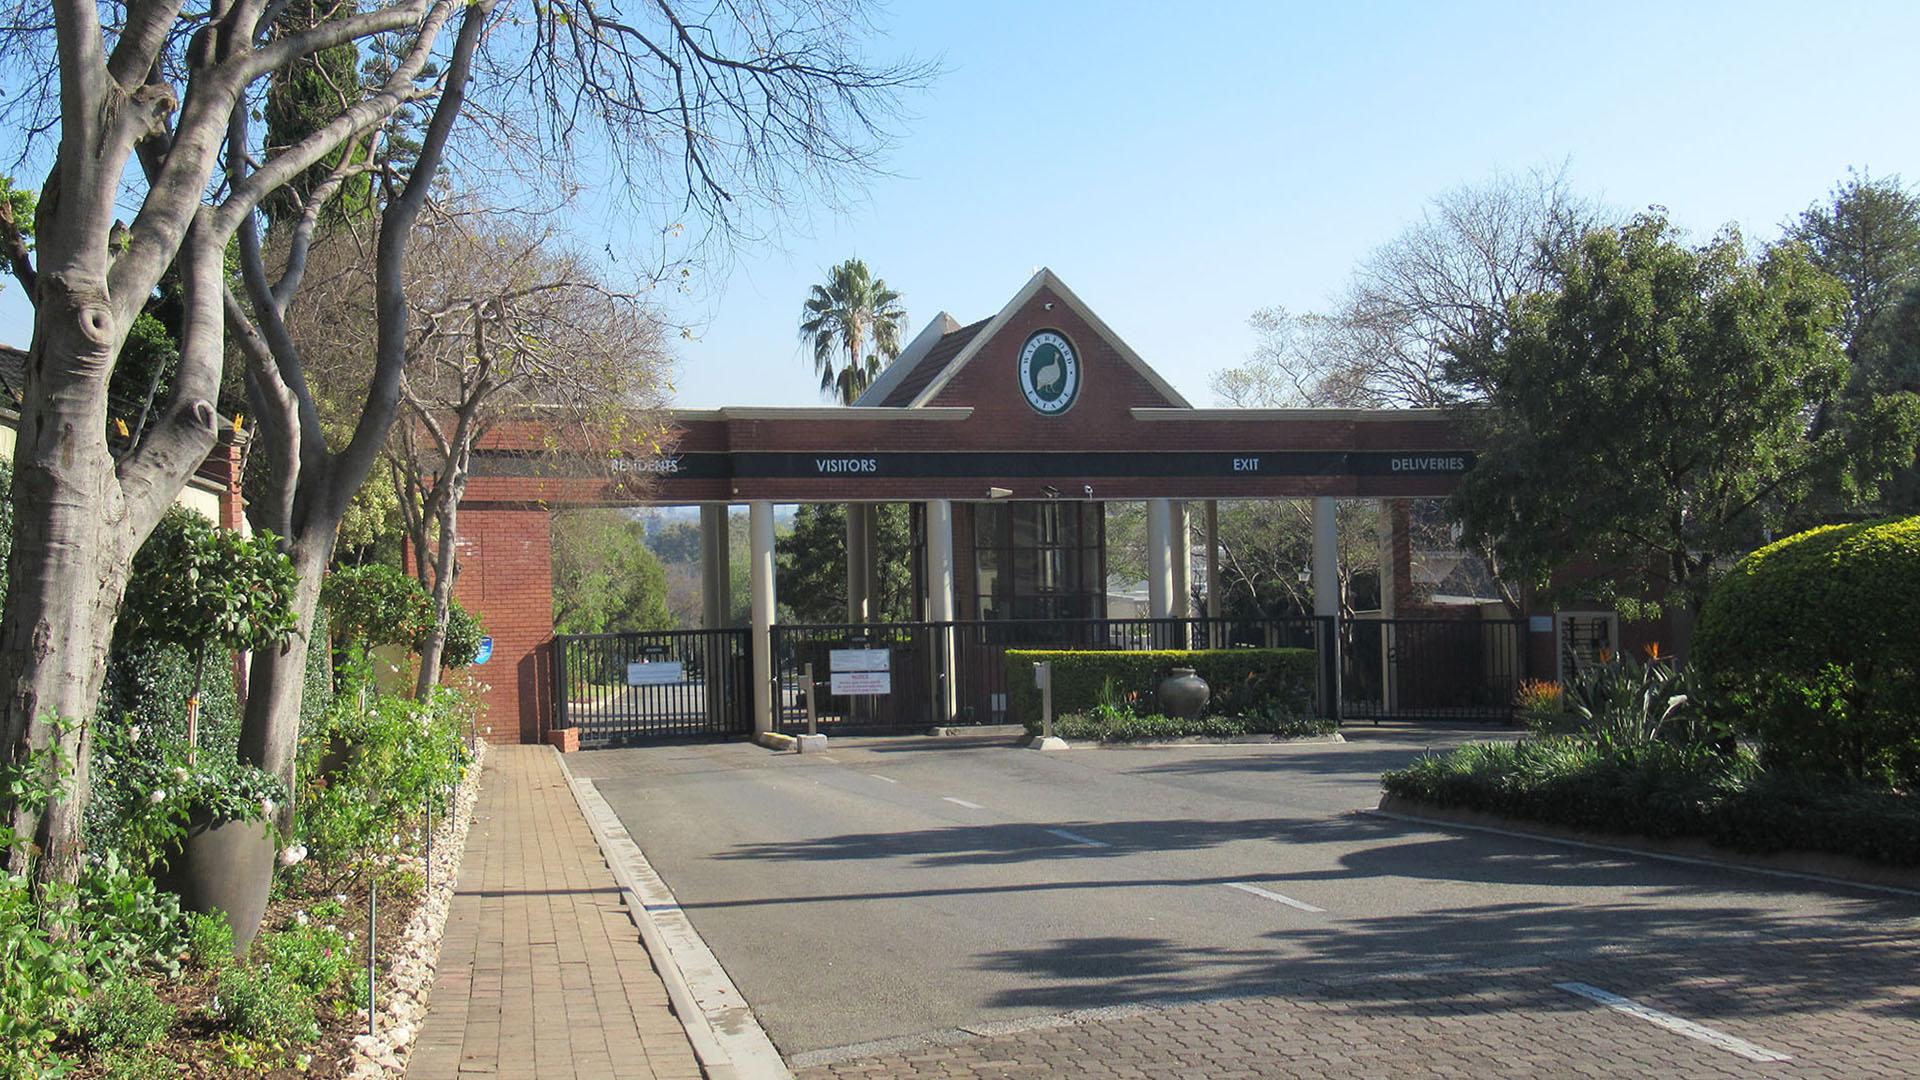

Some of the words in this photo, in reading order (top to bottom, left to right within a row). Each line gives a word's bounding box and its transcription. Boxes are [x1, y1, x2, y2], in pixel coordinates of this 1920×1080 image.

[1023, 335, 1073, 365] WATERFORD
[1028, 390, 1071, 410] ESTATE
[816, 459, 877, 473] VISITORS
[1233, 458, 1259, 471] EXIT
[1392, 457, 1465, 471] DELIVERIES
